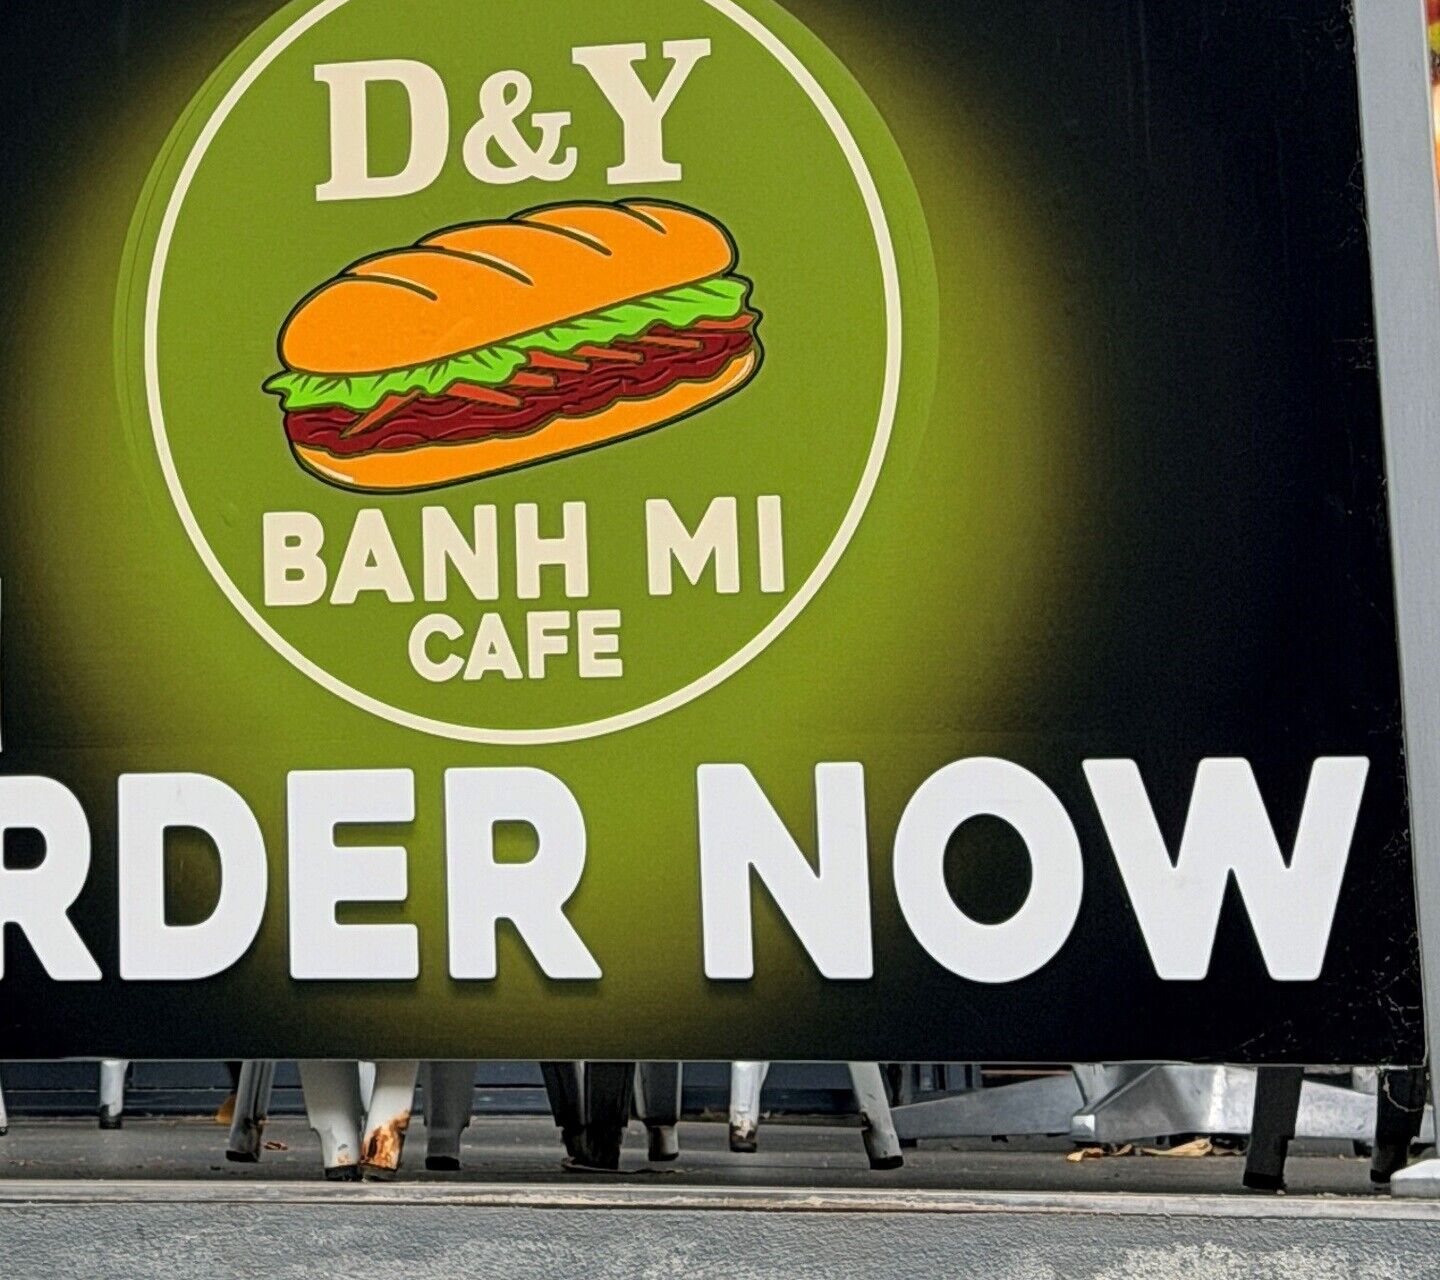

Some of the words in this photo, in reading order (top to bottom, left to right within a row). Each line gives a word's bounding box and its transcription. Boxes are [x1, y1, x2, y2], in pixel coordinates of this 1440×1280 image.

[313, 38, 711, 202] D&Y
[262, 501, 589, 606] BANH
[645, 494, 785, 596] MI
[408, 609, 623, 682] CAFE
[696, 756, 1370, 983] NOW
